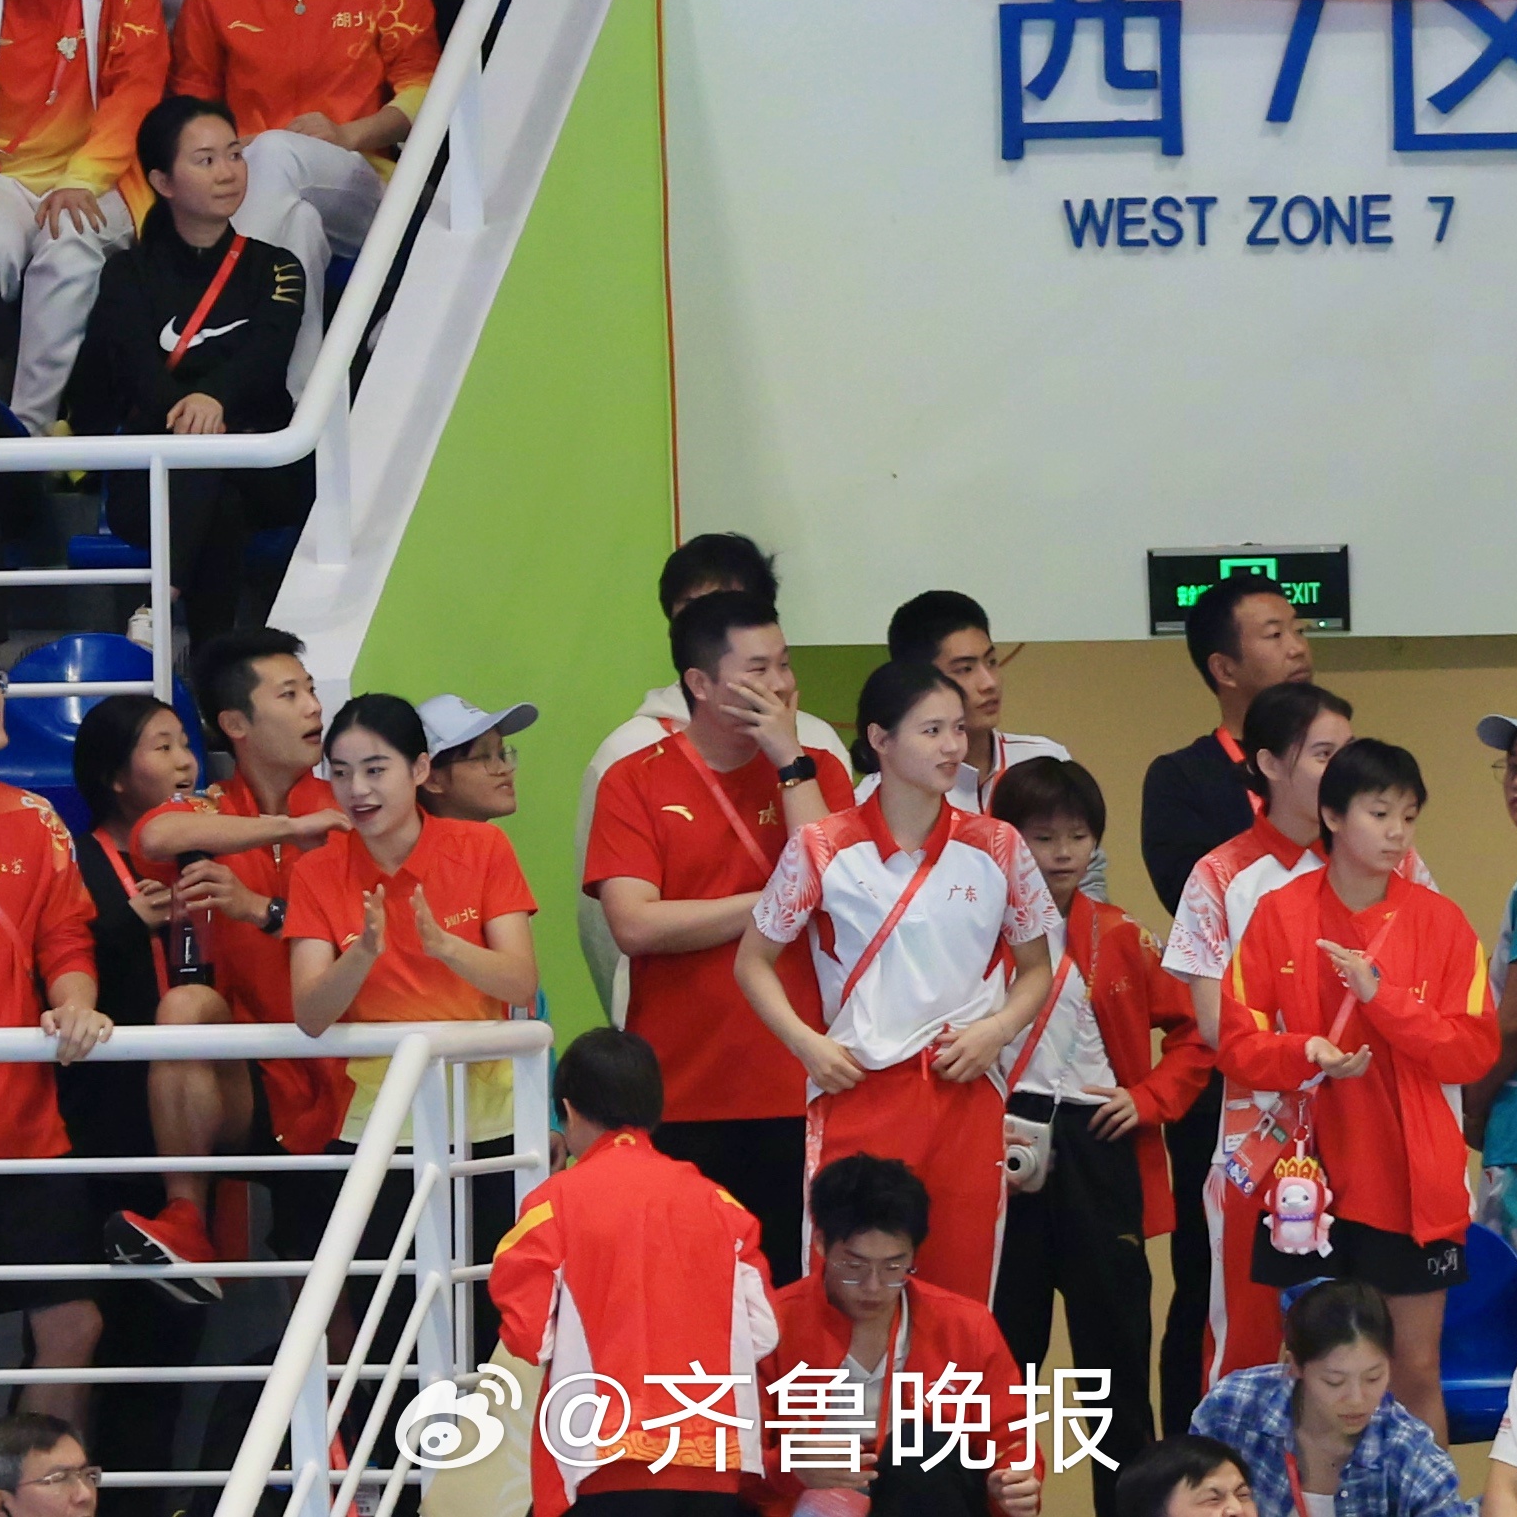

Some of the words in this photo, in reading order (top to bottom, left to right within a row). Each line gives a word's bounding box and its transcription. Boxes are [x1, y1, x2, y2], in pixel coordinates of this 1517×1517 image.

[1064, 196, 1218, 248] WEST
[1247, 194, 1393, 246] ZONE
[1427, 196, 1456, 244] 7
[947, 885, 978, 903] 广东
